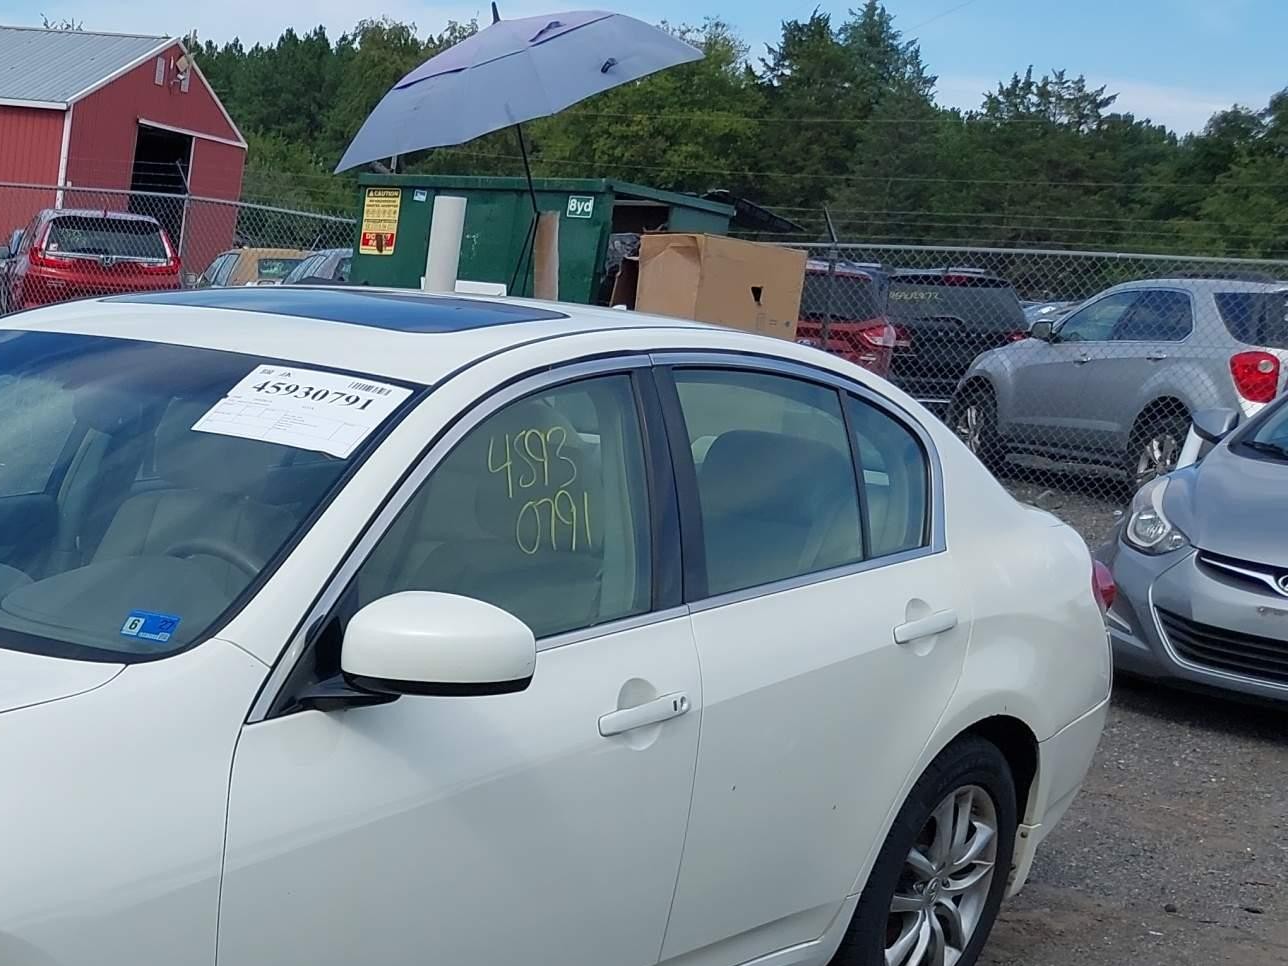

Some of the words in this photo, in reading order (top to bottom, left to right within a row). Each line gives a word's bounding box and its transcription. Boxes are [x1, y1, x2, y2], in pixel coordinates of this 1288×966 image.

[569, 198, 593, 215] 8yd
[252, 380, 375, 410] 45930791
[488, 426, 577, 498] 4593
[516, 490, 592, 554] 0791
[128, 618, 140, 630] 6
